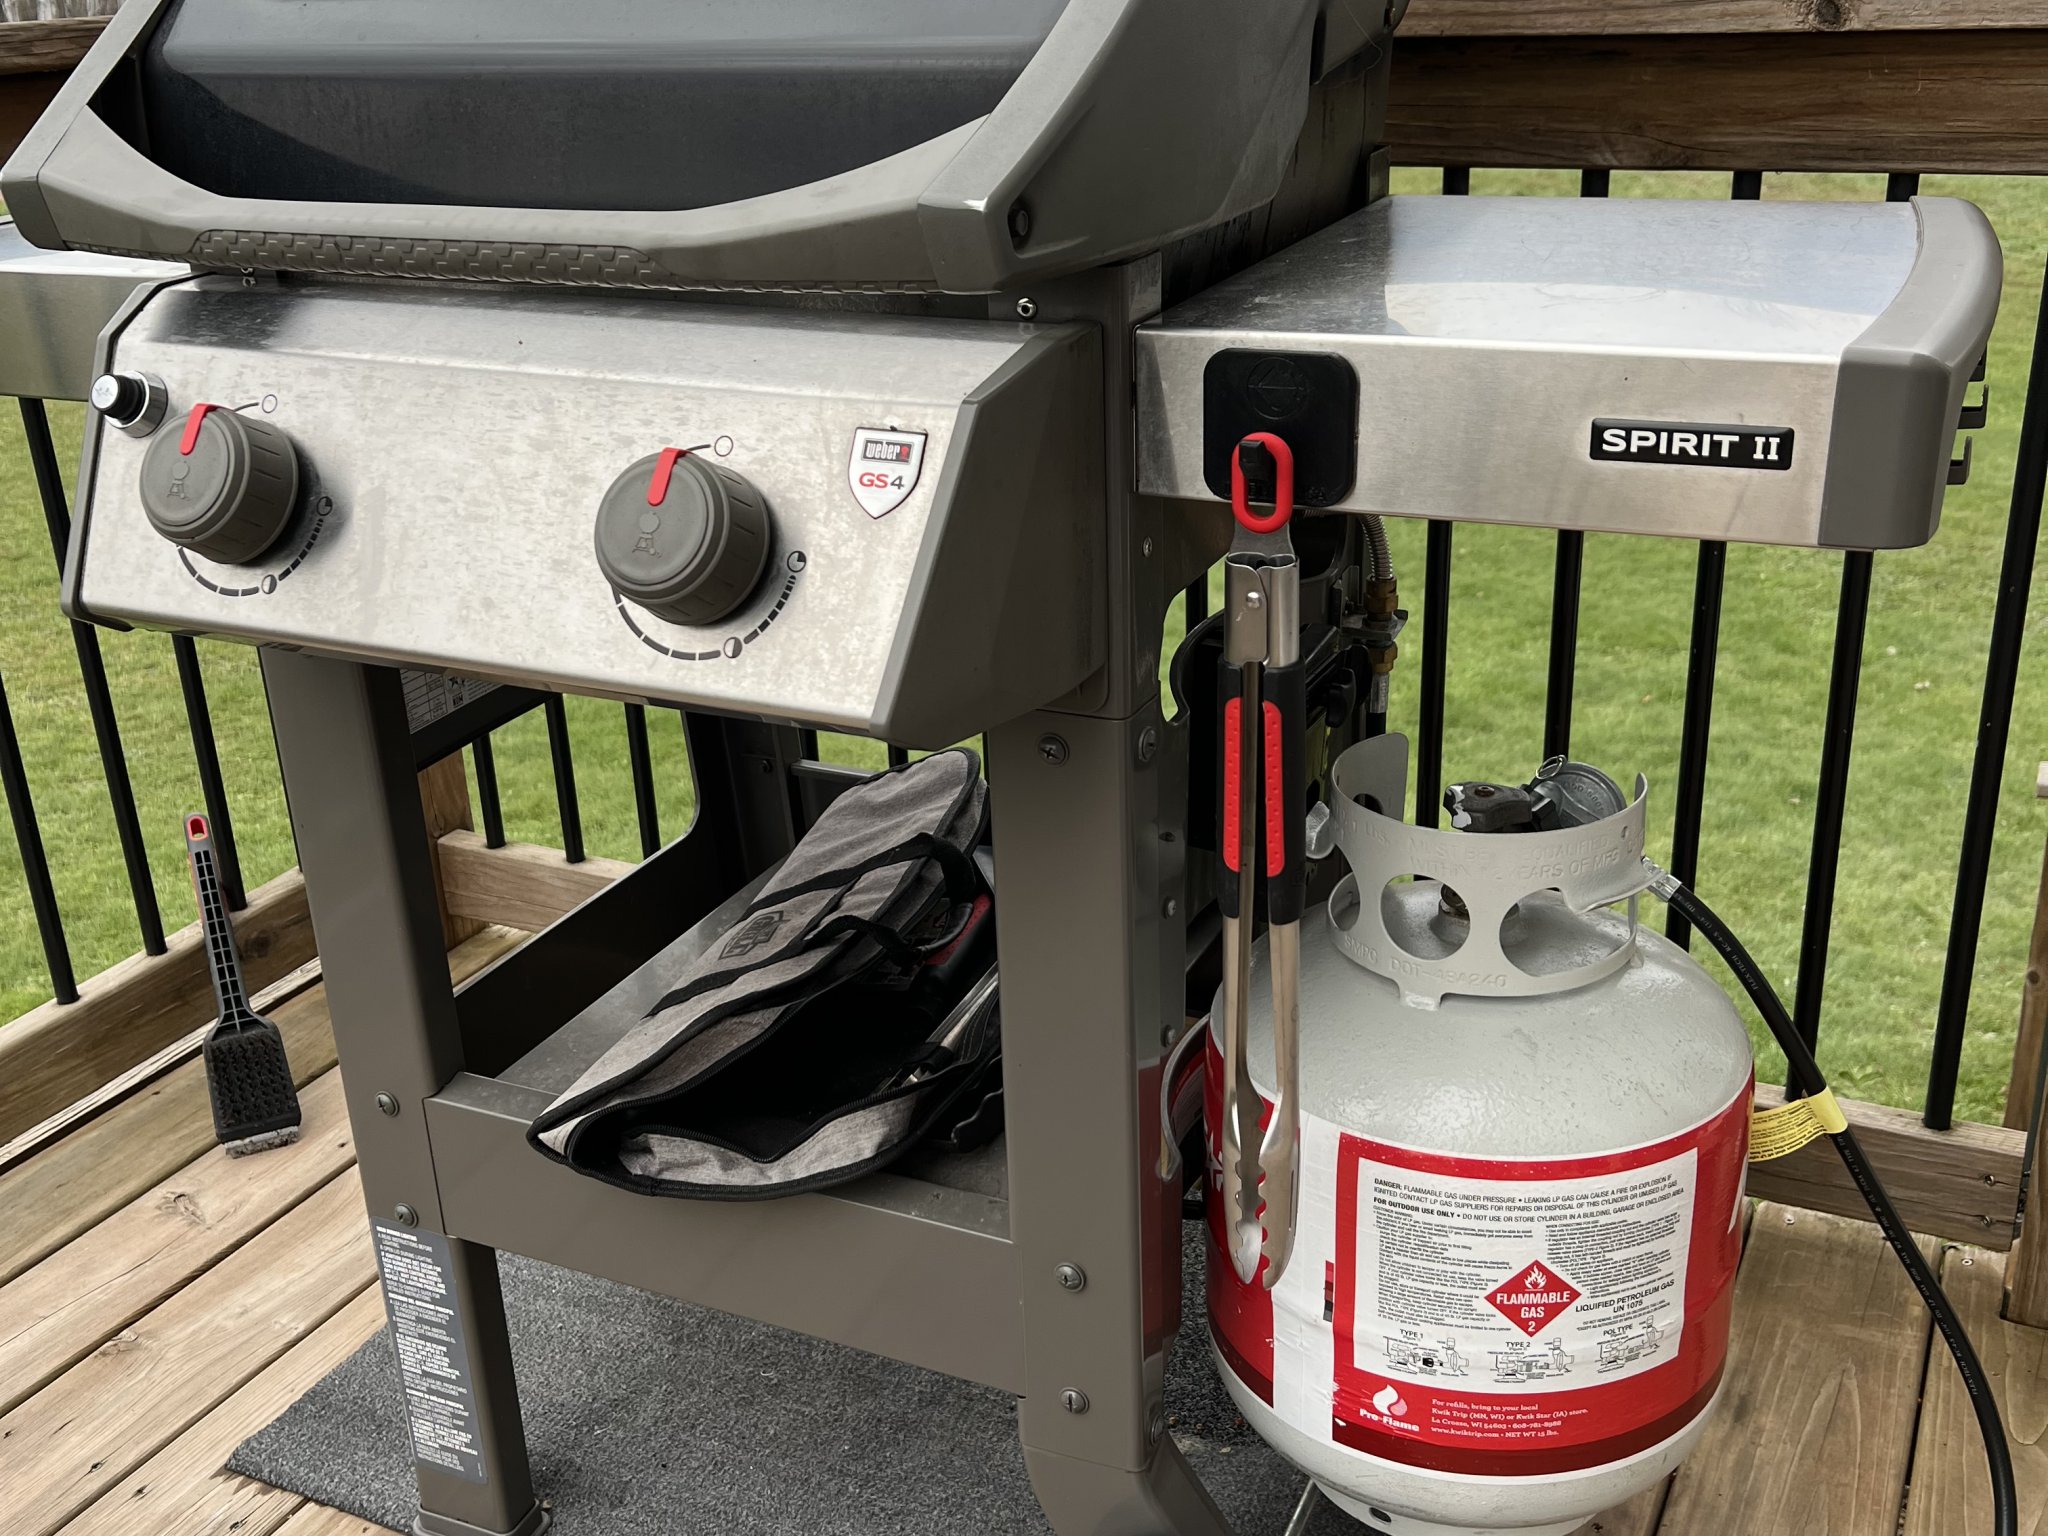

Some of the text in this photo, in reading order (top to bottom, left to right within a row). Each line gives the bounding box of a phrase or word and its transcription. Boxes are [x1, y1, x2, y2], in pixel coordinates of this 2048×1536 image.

[865, 440, 901, 461] weber
[1602, 427, 1781, 461] SPIRIT II
[1464, 846, 1489, 863] BE
[1516, 834, 1611, 862] EQUALIFIED
[1374, 1178, 1402, 1190] DANGER:
[1404, 1185, 1442, 1197] FLAMMABLE
[1444, 1191, 1457, 1199] GAS
[1590, 1190, 1609, 1199] CAUSE
[1639, 1176, 1666, 1190] EXPLOSION
[1374, 1187, 1397, 1197] IGNITED
[1399, 1192, 1428, 1203] CONTACT
[1454, 1202, 1489, 1210] SUPPLIERS
[1601, 1195, 1628, 1206] CYLINDER
[1639, 1186, 1659, 1197] UNUSED
[1668, 1180, 1677, 1188] GAS
[1374, 1197, 1386, 1205] FOR
[1388, 1200, 1419, 1212] OUTDOOR
[1421, 1207, 1434, 1215] USE
[1437, 1210, 1454, 1218] ONLY
[1613, 1204, 1635, 1214] GARAGE
[1645, 1193, 1671, 1206] ENCLOSED
[1672, 1187, 1684, 1197] AREA
[1496, 1290, 1571, 1305] FLAMMABLE
[1575, 1299, 1615, 1312] LIQUIFIED
[1617, 1285, 1659, 1304] PETROLEUM
[1661, 1279, 1675, 1290] GAS
[1520, 1306, 1545, 1319] GAS
[1613, 1305, 1625, 1313] UN
[1627, 1300, 1643, 1310] 1075
[1528, 1320, 1536, 1332] 2
[1603, 1327, 1616, 1336] POL
[1617, 1323, 1633, 1332] TYPE
[1400, 1329, 1420, 1338] TYPE
[1446, 1401, 1470, 1410] refills,
[1471, 1403, 1491, 1411] bring
[1359, 1408, 1419, 1432] Pro-Flame
[1432, 1408, 1450, 1416] Kwik
[1452, 1411, 1468, 1419] Trip
[1470, 1412, 1488, 1420] (MN,
[1442, 1418, 1469, 1427] Crosse,
[1430, 1426, 1499, 1438] www.kwiktrip.com
